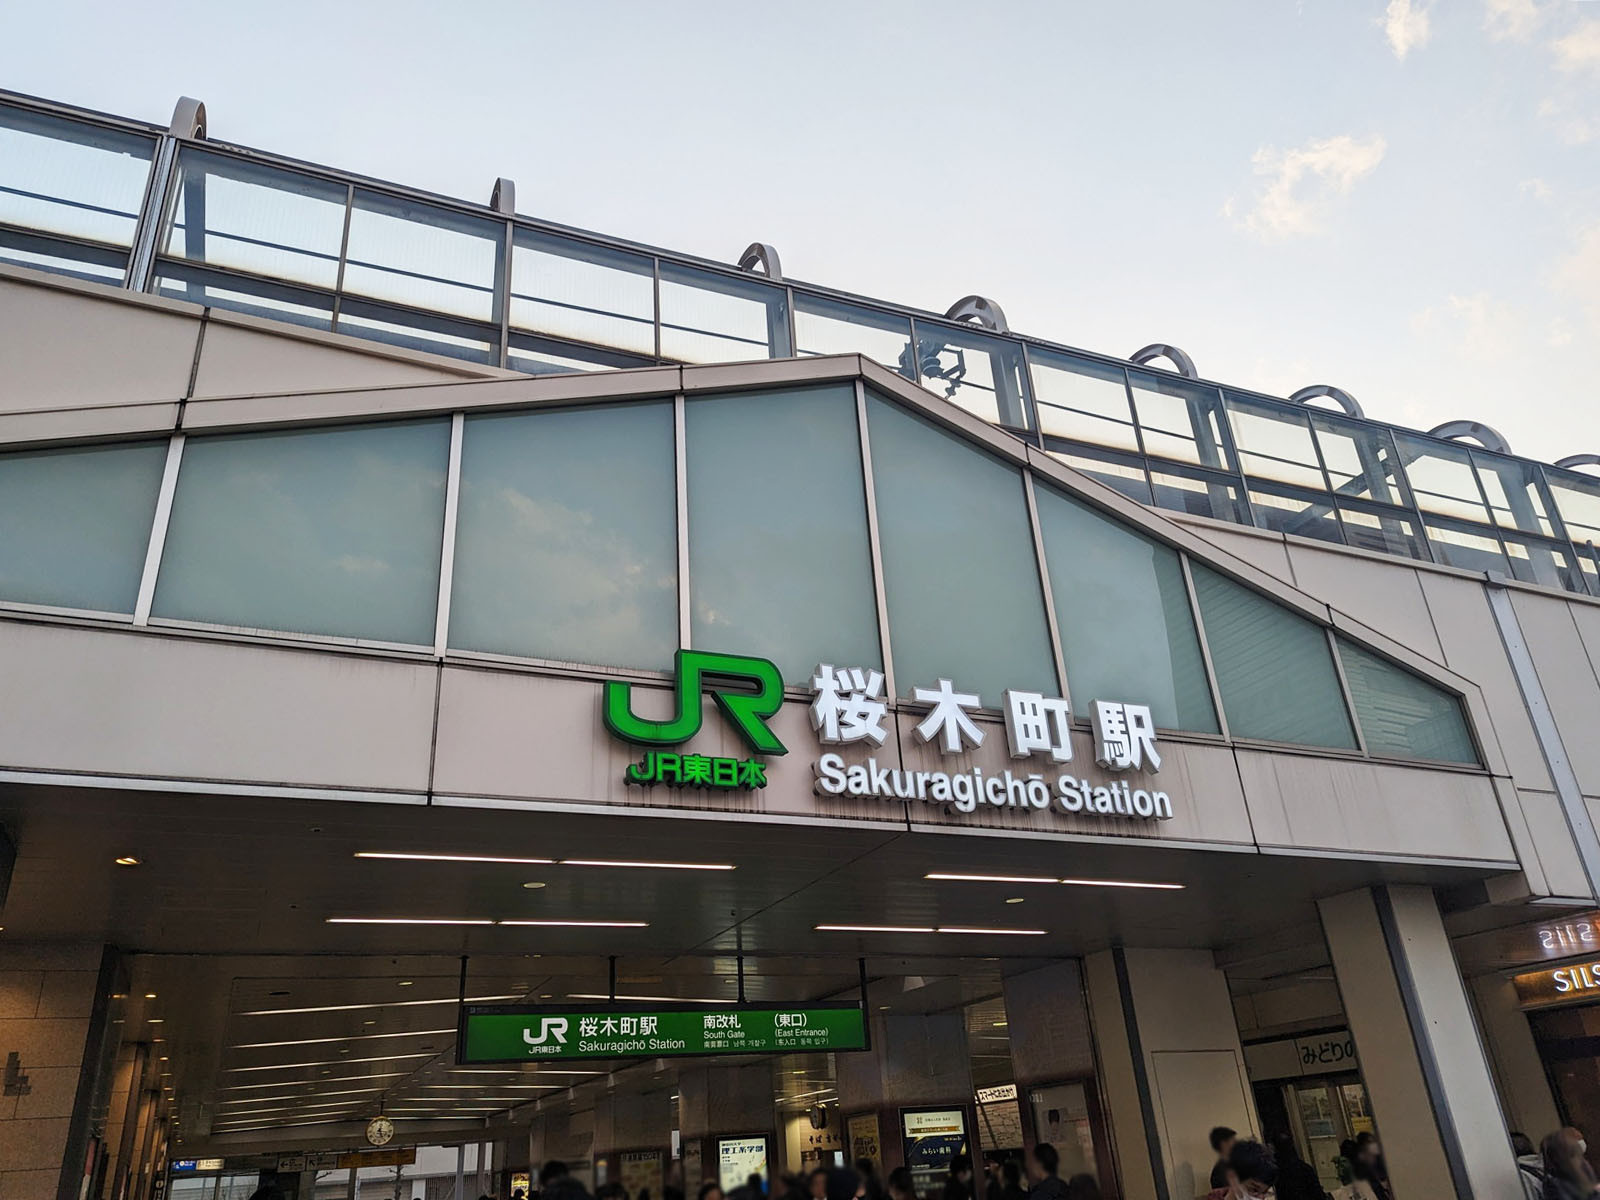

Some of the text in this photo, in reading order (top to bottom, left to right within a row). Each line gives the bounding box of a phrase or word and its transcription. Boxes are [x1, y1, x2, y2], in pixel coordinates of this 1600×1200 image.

[603, 648, 788, 756] JR
[810, 663, 1162, 773] 桜木町駅
[627, 751, 767, 790] JR東日本
[814, 752, 1174, 820] Sakuragichō Station
[523, 1017, 568, 1044] JR
[579, 1017, 658, 1037] 桜木町駅
[703, 1014, 741, 1029] 南改札
[703, 1029, 745, 1039] South Gate
[775, 1028, 829, 1037] (East Entrance)
[528, 1046, 562, 1054] JR東日本
[579, 1038, 685, 1053] Sakuragichō Station
